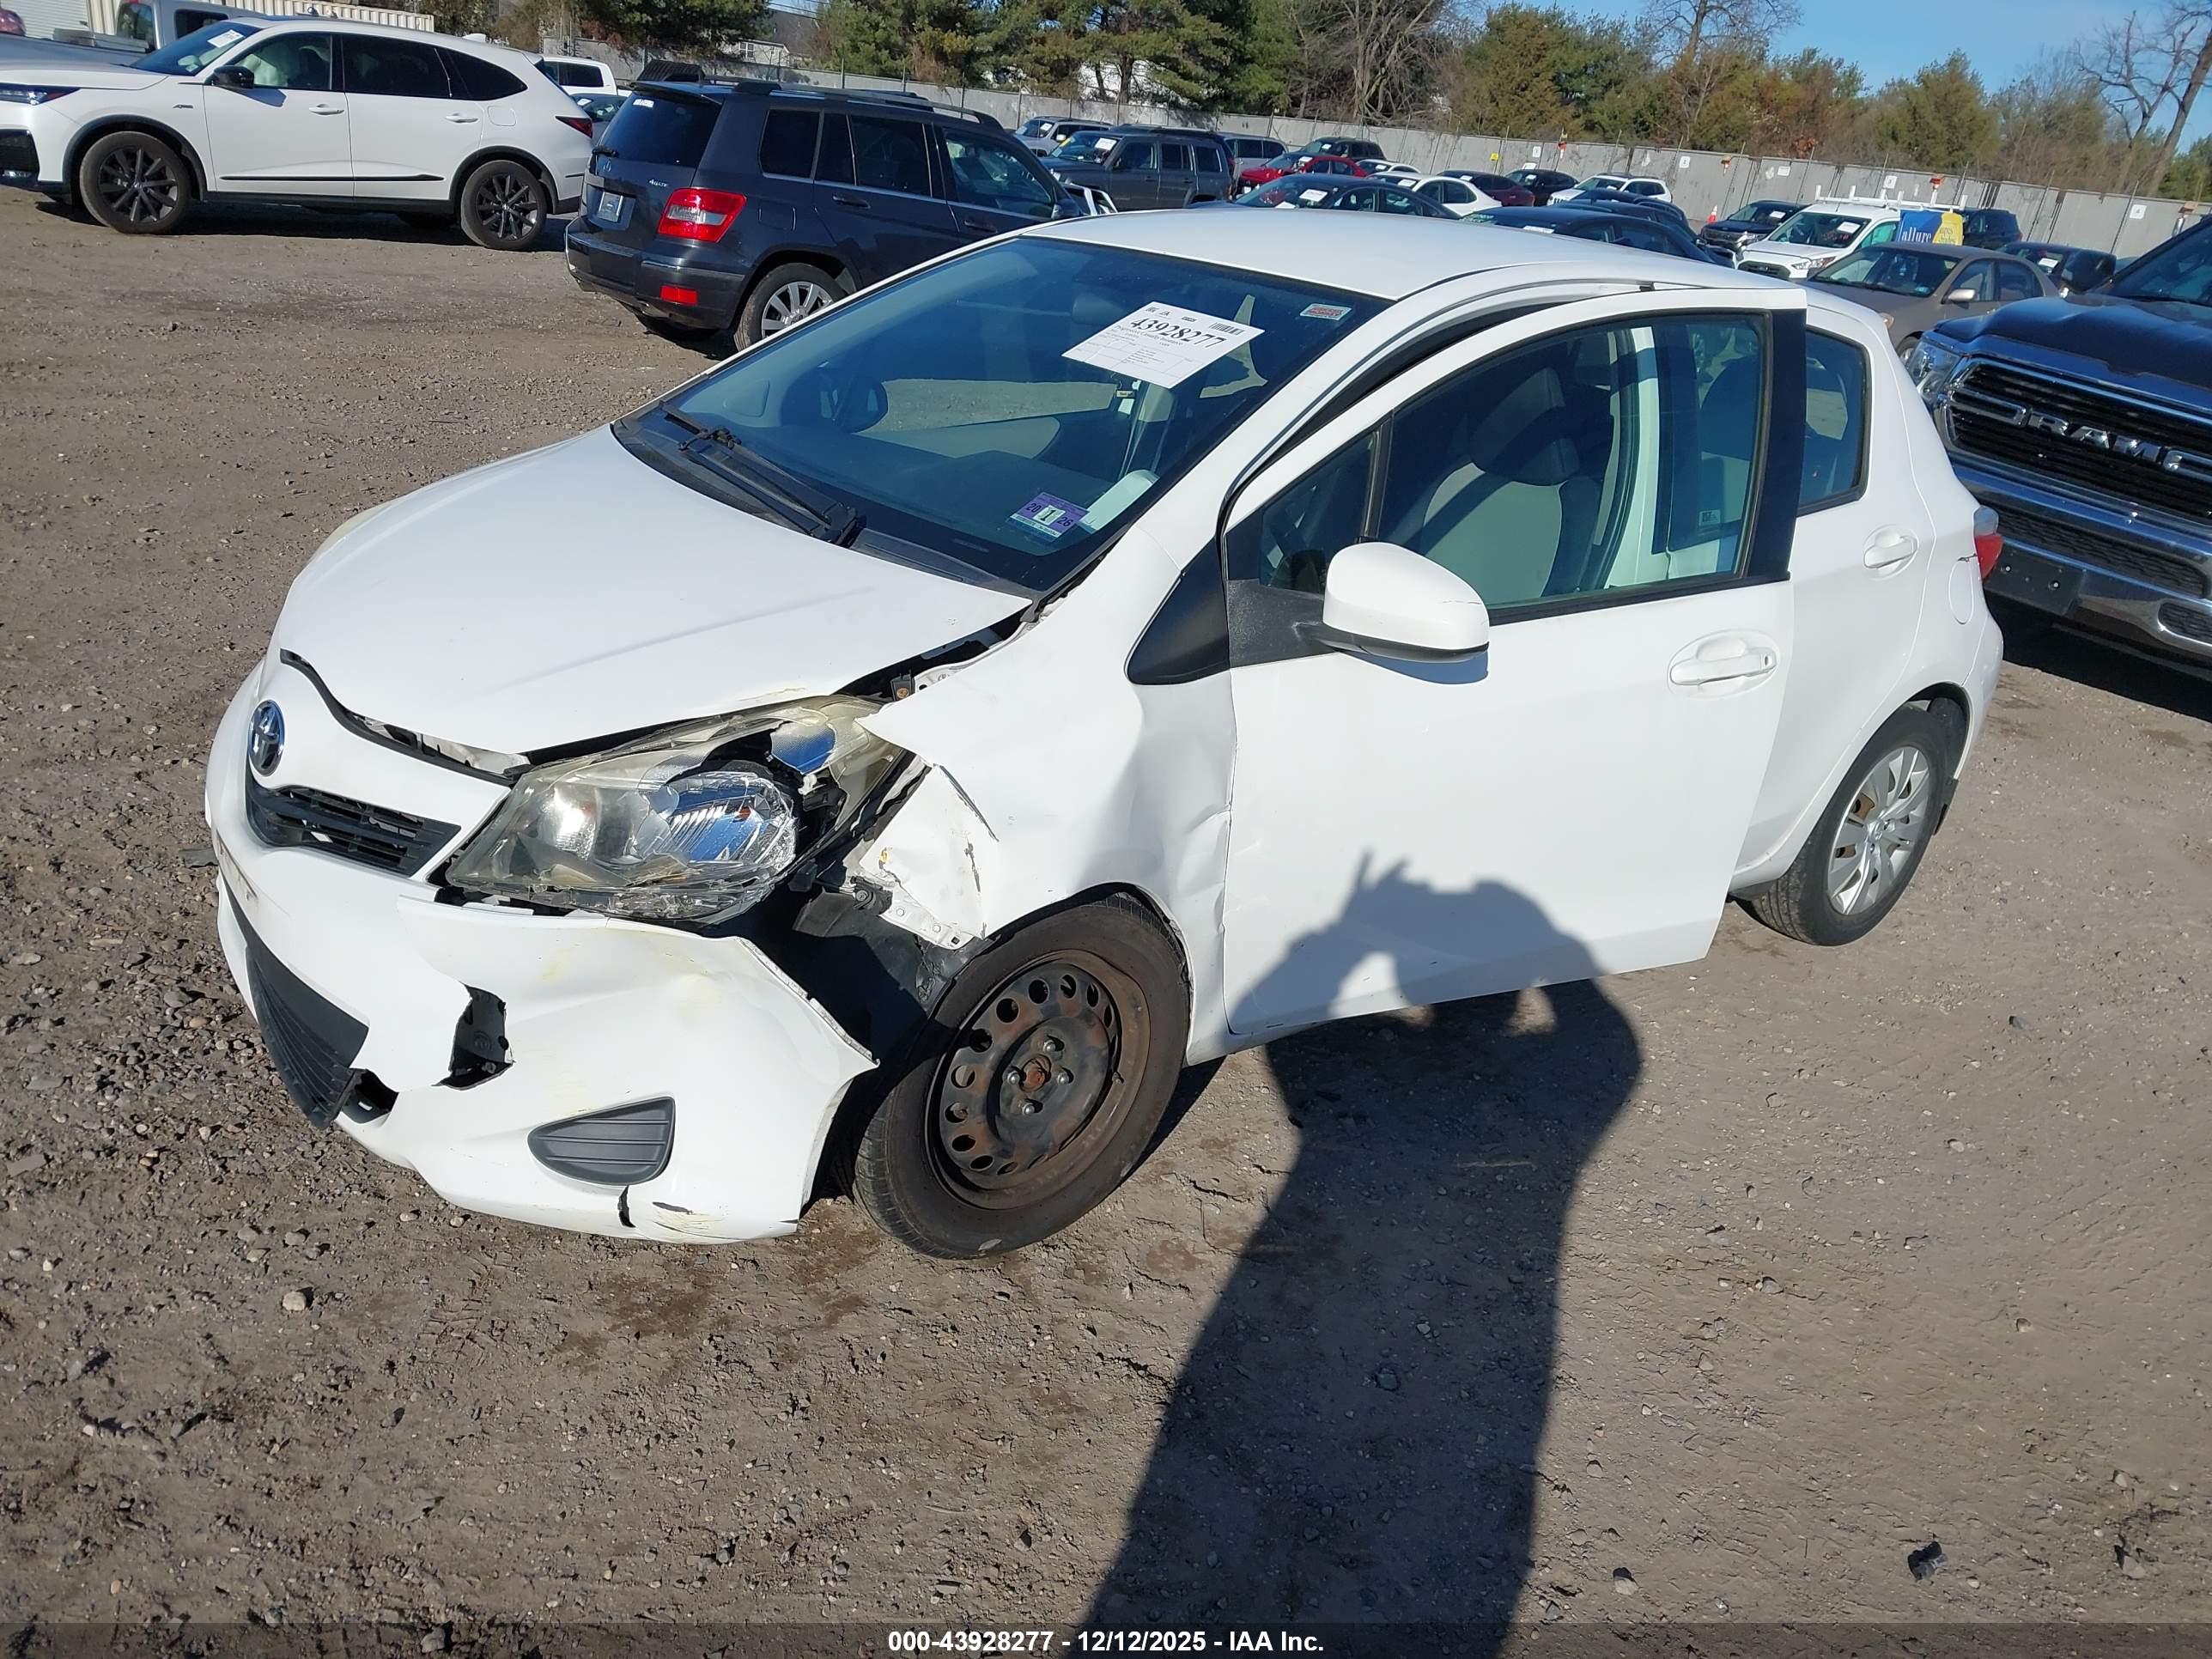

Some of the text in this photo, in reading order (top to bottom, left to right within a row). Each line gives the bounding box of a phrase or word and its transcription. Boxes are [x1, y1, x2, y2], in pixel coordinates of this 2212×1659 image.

[1901, 227, 1932, 243] allure
[1130, 318, 1226, 349] 43928277
[2027, 409, 2162, 465] RAM
[1025, 502, 1042, 514] 20
[1040, 509, 1056, 521] 1
[1057, 517, 1074, 527] 26
